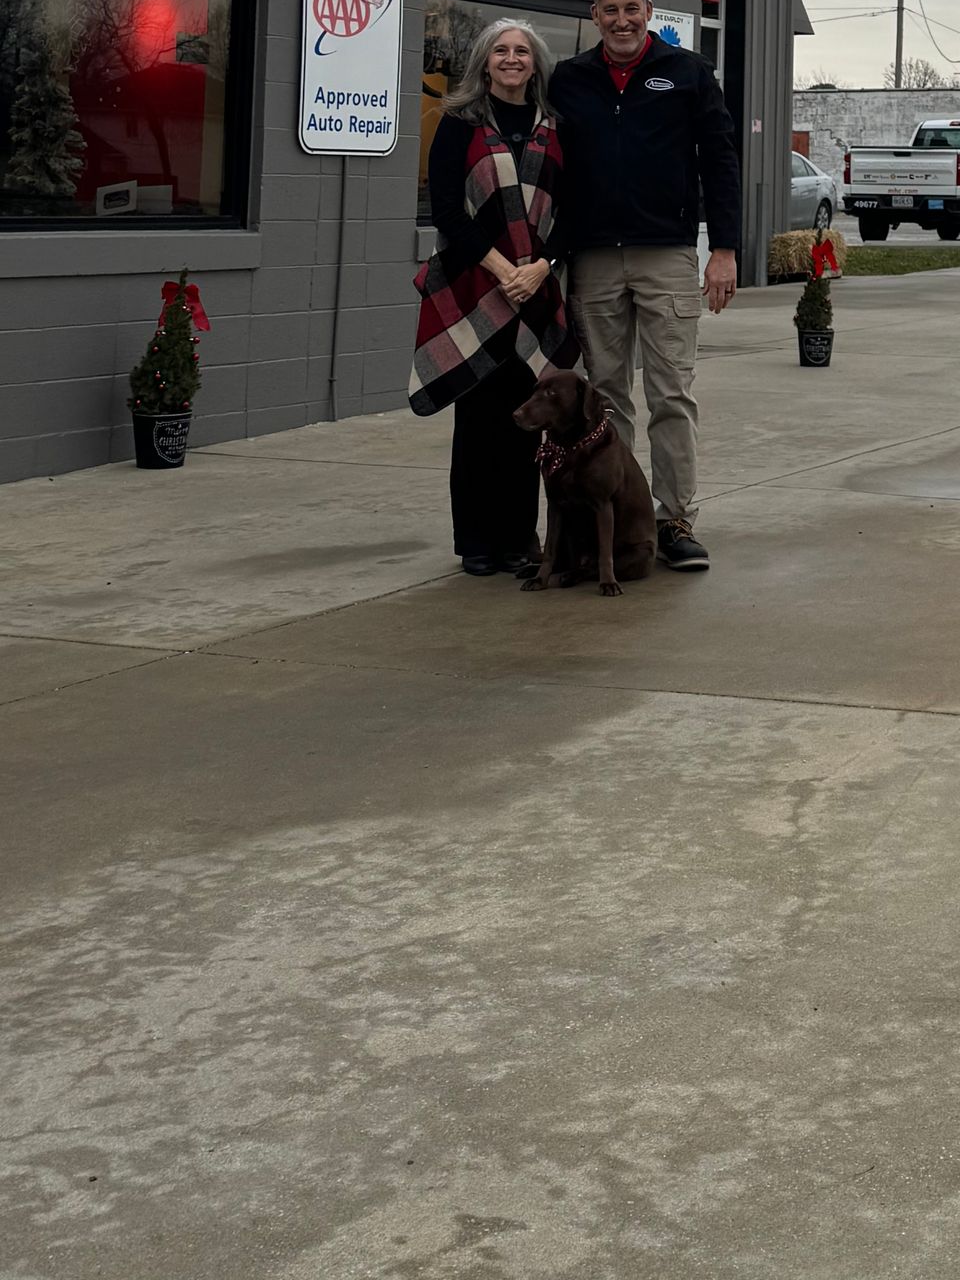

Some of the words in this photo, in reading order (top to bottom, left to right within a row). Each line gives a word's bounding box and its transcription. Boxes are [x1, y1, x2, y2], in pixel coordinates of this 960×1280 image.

[314, 86, 388, 109] Approved
[307, 113, 343, 132] Auto
[349, 115, 392, 138] Repair
